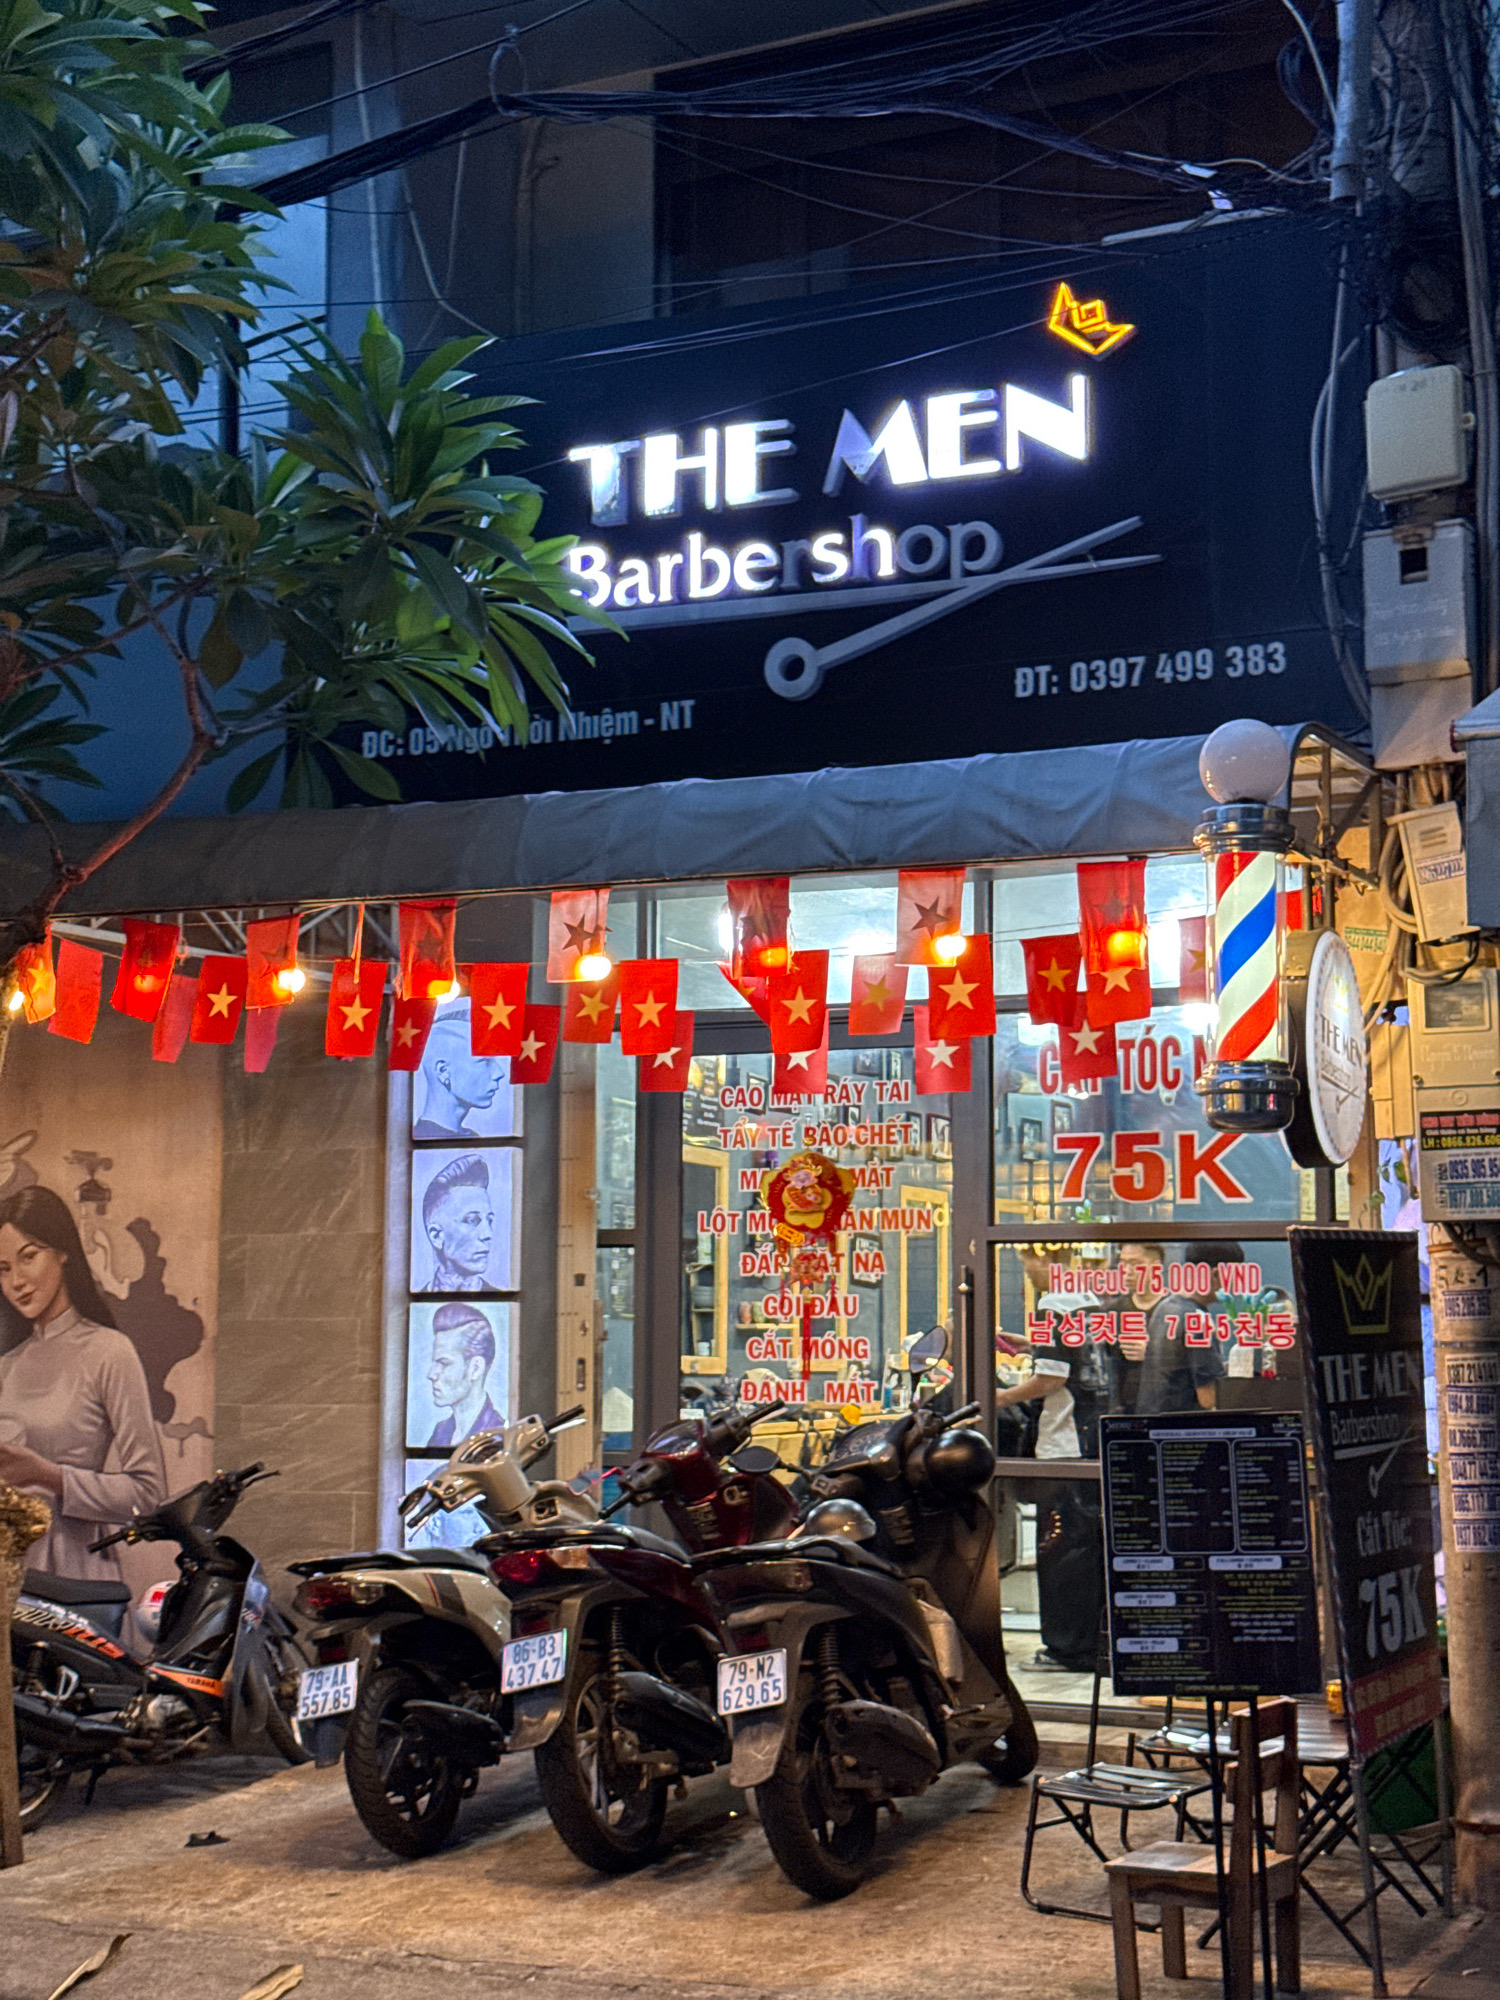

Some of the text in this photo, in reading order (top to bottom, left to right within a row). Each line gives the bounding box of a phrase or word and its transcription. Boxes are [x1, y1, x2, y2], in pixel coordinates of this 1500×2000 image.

[567, 373, 1088, 526] THE MEN
[568, 514, 1001, 607] Barbershop
[1014, 641, 1287, 698] ĐT: 0397 499 383
[362, 729, 404, 759] ĐC:
[660, 699, 696, 732] NT
[1118, 1024, 1182, 1094] TÓC
[720, 1086, 764, 1112] CẠO
[823, 1078, 866, 1106] RÁY
[875, 1080, 911, 1103] TAI
[718, 1114, 913, 1149] TẨY TẾ BÀO CHẾT
[1053, 1130, 1254, 1204] 75K
[697, 1207, 741, 1238] LỘT
[880, 1208, 932, 1236] MỤN
[853, 1251, 887, 1279] NẠ
[1049, 1262, 1129, 1295] Haircut
[1217, 1262, 1262, 1295] VND
[1028, 1310, 1149, 1347] 남성컷트
[746, 1331, 869, 1361] CẮT MÓNG
[825, 1372, 879, 1404] MẮT
[1318, 1352, 1370, 1403] THE
[1329, 1405, 1401, 1447] Barbershop
[1359, 1564, 1429, 1662] 75K
[512, 1634, 558, 1665] 86-B3
[305, 1664, 348, 1694] 79-AA
[505, 1657, 562, 1690] 437.47
[728, 1655, 776, 1688] 79-N2
[300, 1686, 351, 1718] 557.85
[721, 1679, 784, 1713] 629.65
